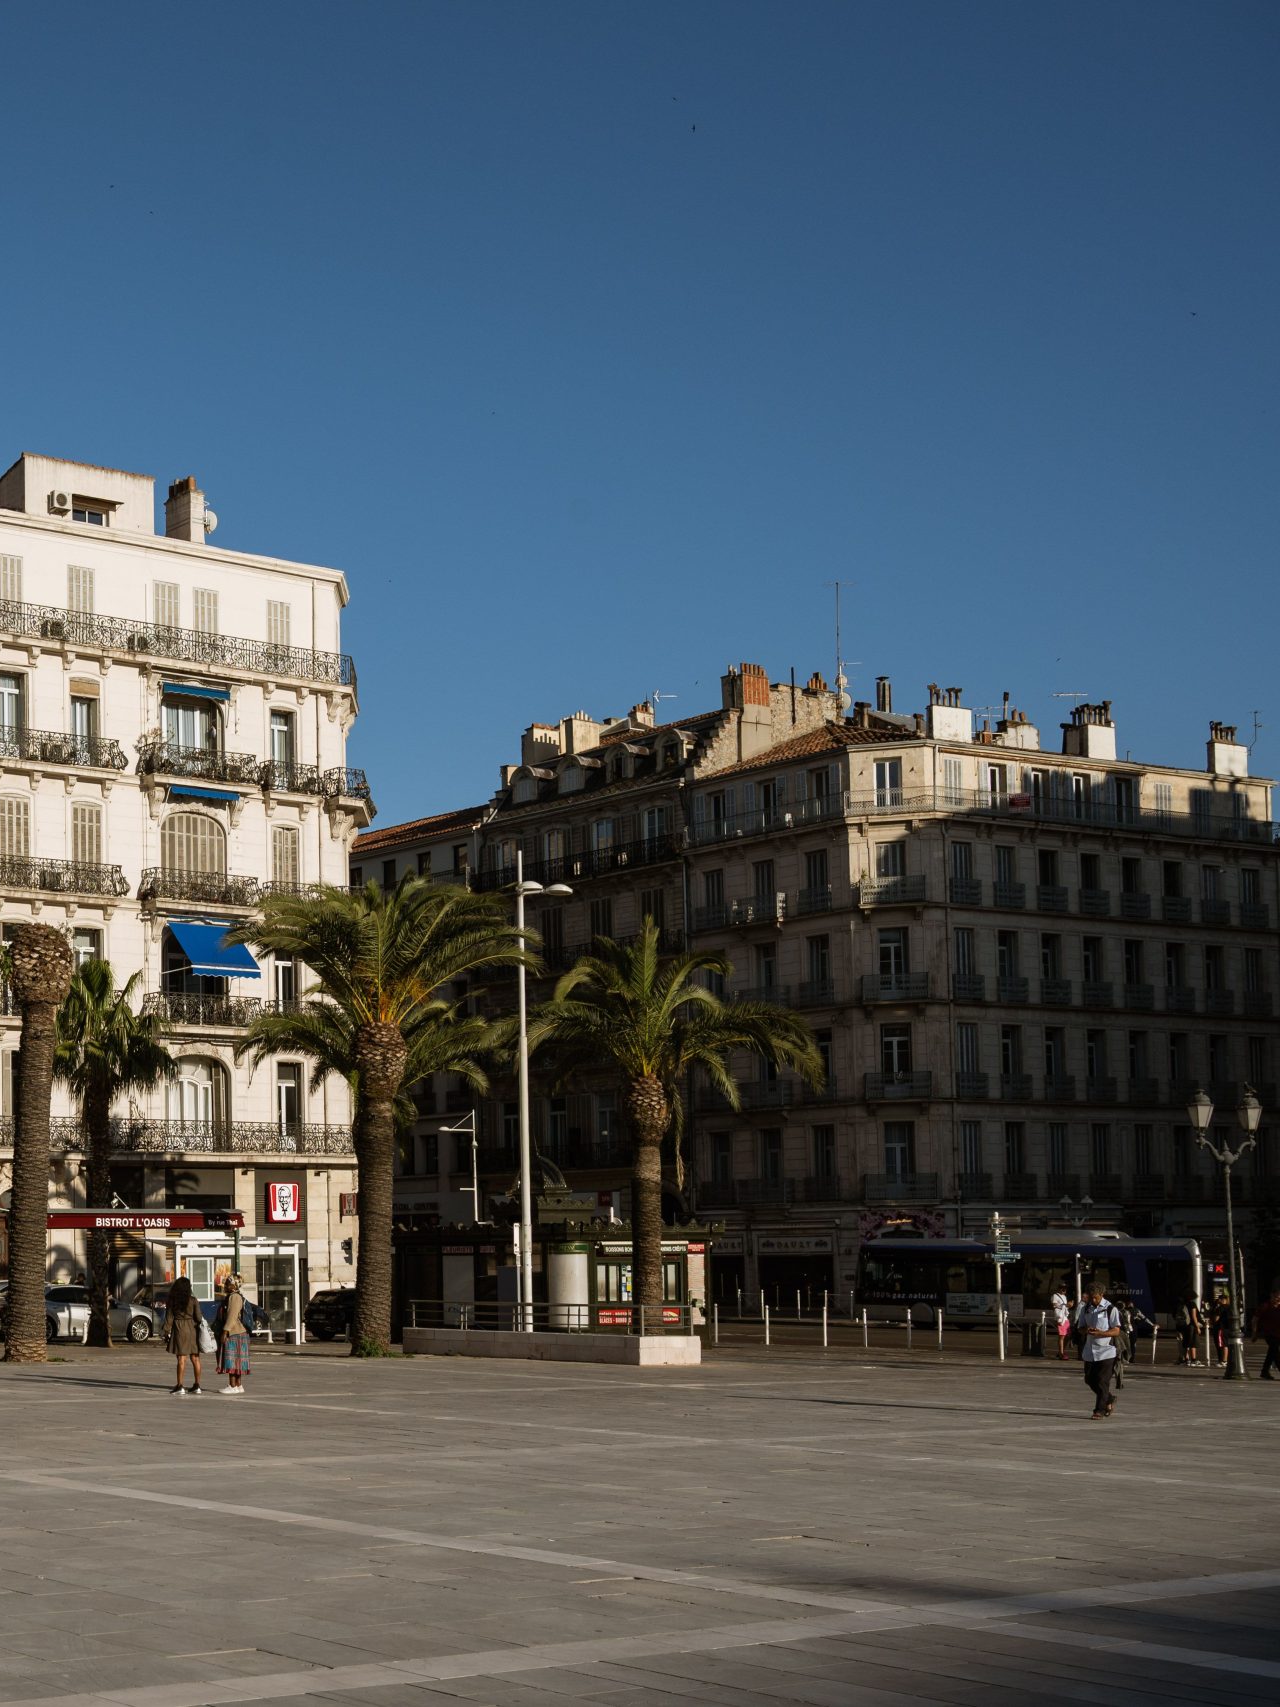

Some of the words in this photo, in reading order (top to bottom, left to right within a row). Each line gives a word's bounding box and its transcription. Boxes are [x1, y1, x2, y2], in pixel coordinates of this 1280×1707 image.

[95, 1217, 134, 1227] BISTROT
[136, 1217, 171, 1228] L'OASIS
[908, 1291, 937, 1300] naturel
